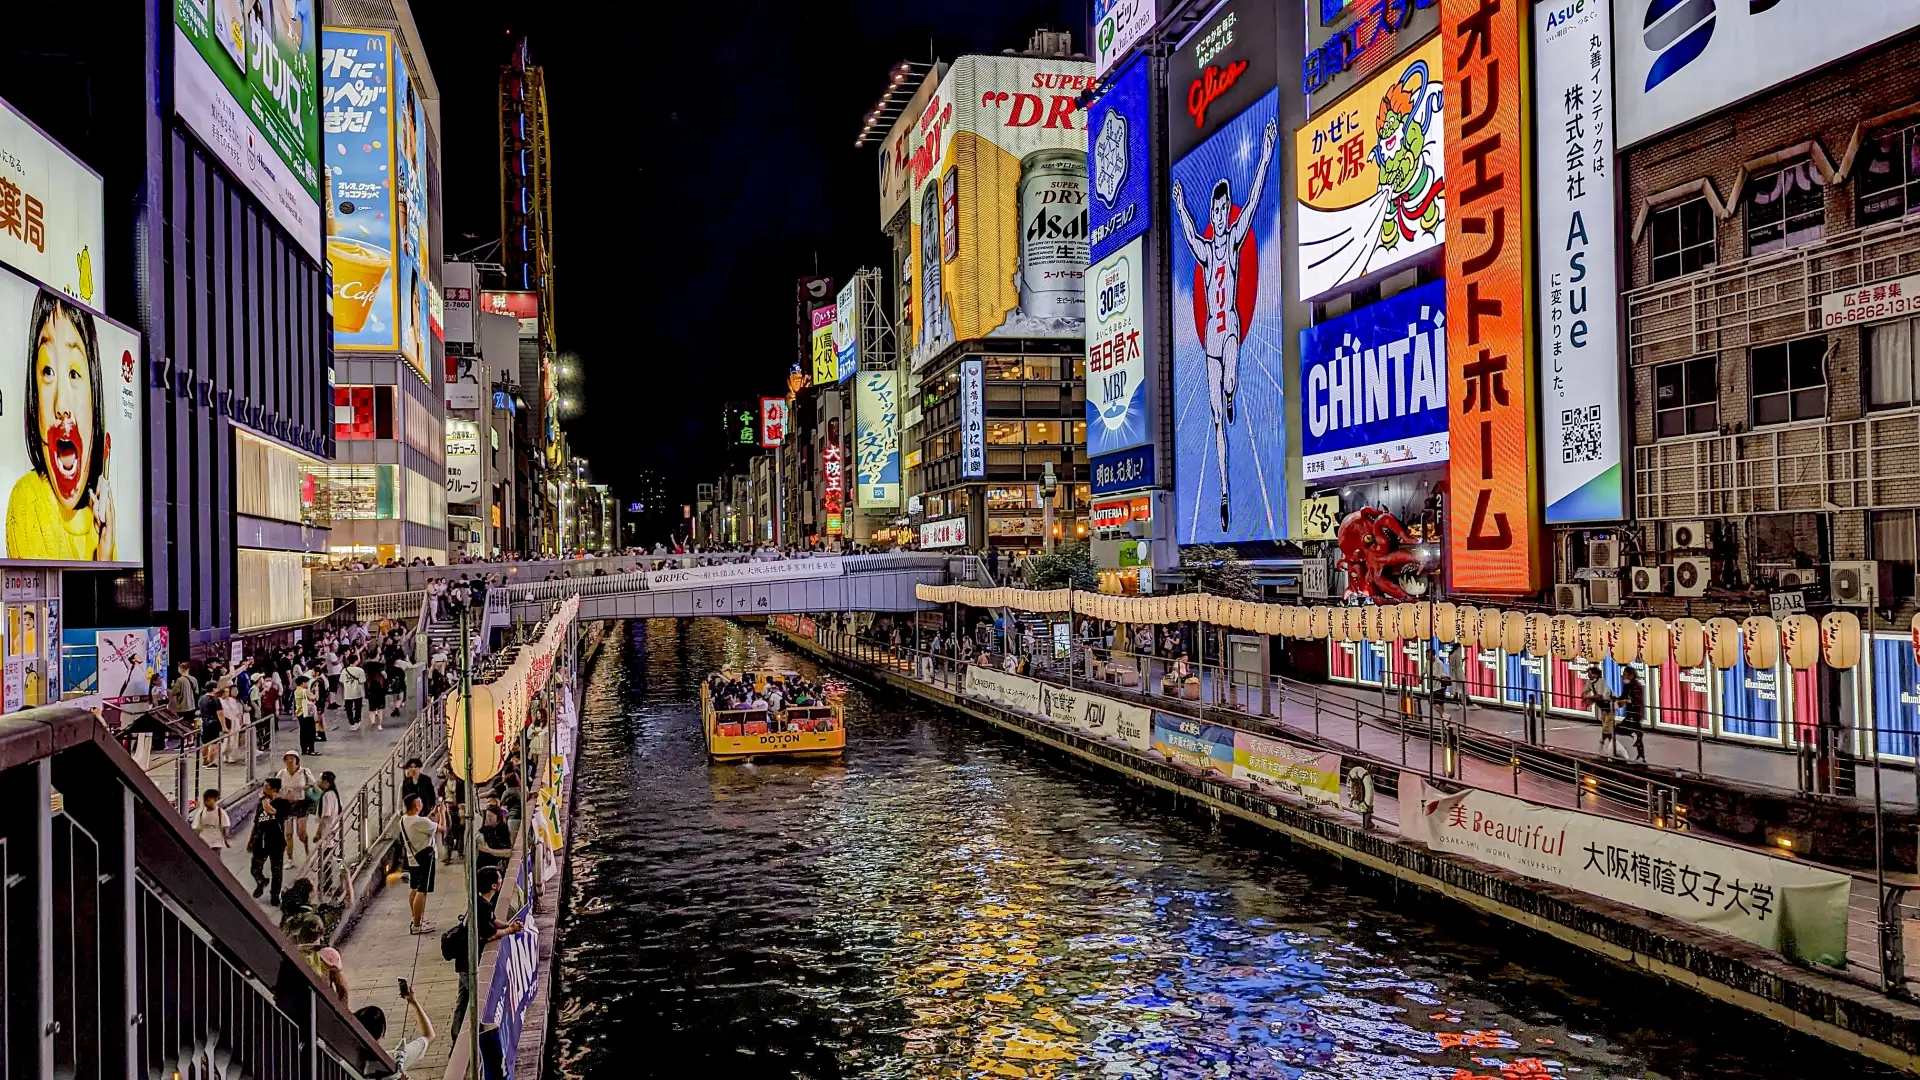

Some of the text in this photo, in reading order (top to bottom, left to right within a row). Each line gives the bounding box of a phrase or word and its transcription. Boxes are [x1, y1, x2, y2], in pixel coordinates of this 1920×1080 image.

[1195, 12, 1237, 57] すこやかな毎日、
[1198, 31, 1233, 69] ゆたかな人生
[1590, 34, 1605, 178] 丸善インテックは、
[1312, 109, 1360, 154] かぜに
[1051, 181, 1079, 189] SUPER
[1307, 130, 1365, 202] 改源
[0, 176, 45, 253] 薬局
[1565, 84, 1589, 348] 株式会社 Asue
[1044, 271, 1084, 279] スーパードラ
[1056, 246, 1075, 260] 生
[1215, 261, 1227, 334] グリコ
[1825, 295, 1920, 326] 06-6262-1313
[1844, 283, 1902, 307] 広告募集
[815, 334, 823, 382] バイト
[823, 333, 833, 380] 高収入
[1089, 328, 1140, 373] 毎日骨太
[1551, 273, 1564, 398] に変わりました。
[969, 420, 981, 472] かに道楽
[695, 597, 768, 609] えびす橋
[1772, 594, 1804, 612] BAR
[760, 735, 800, 744] DOTON
[1449, 803, 1566, 857] 美 Beautiful
[1583, 841, 1774, 921] 大阪樟蔭女子大学
